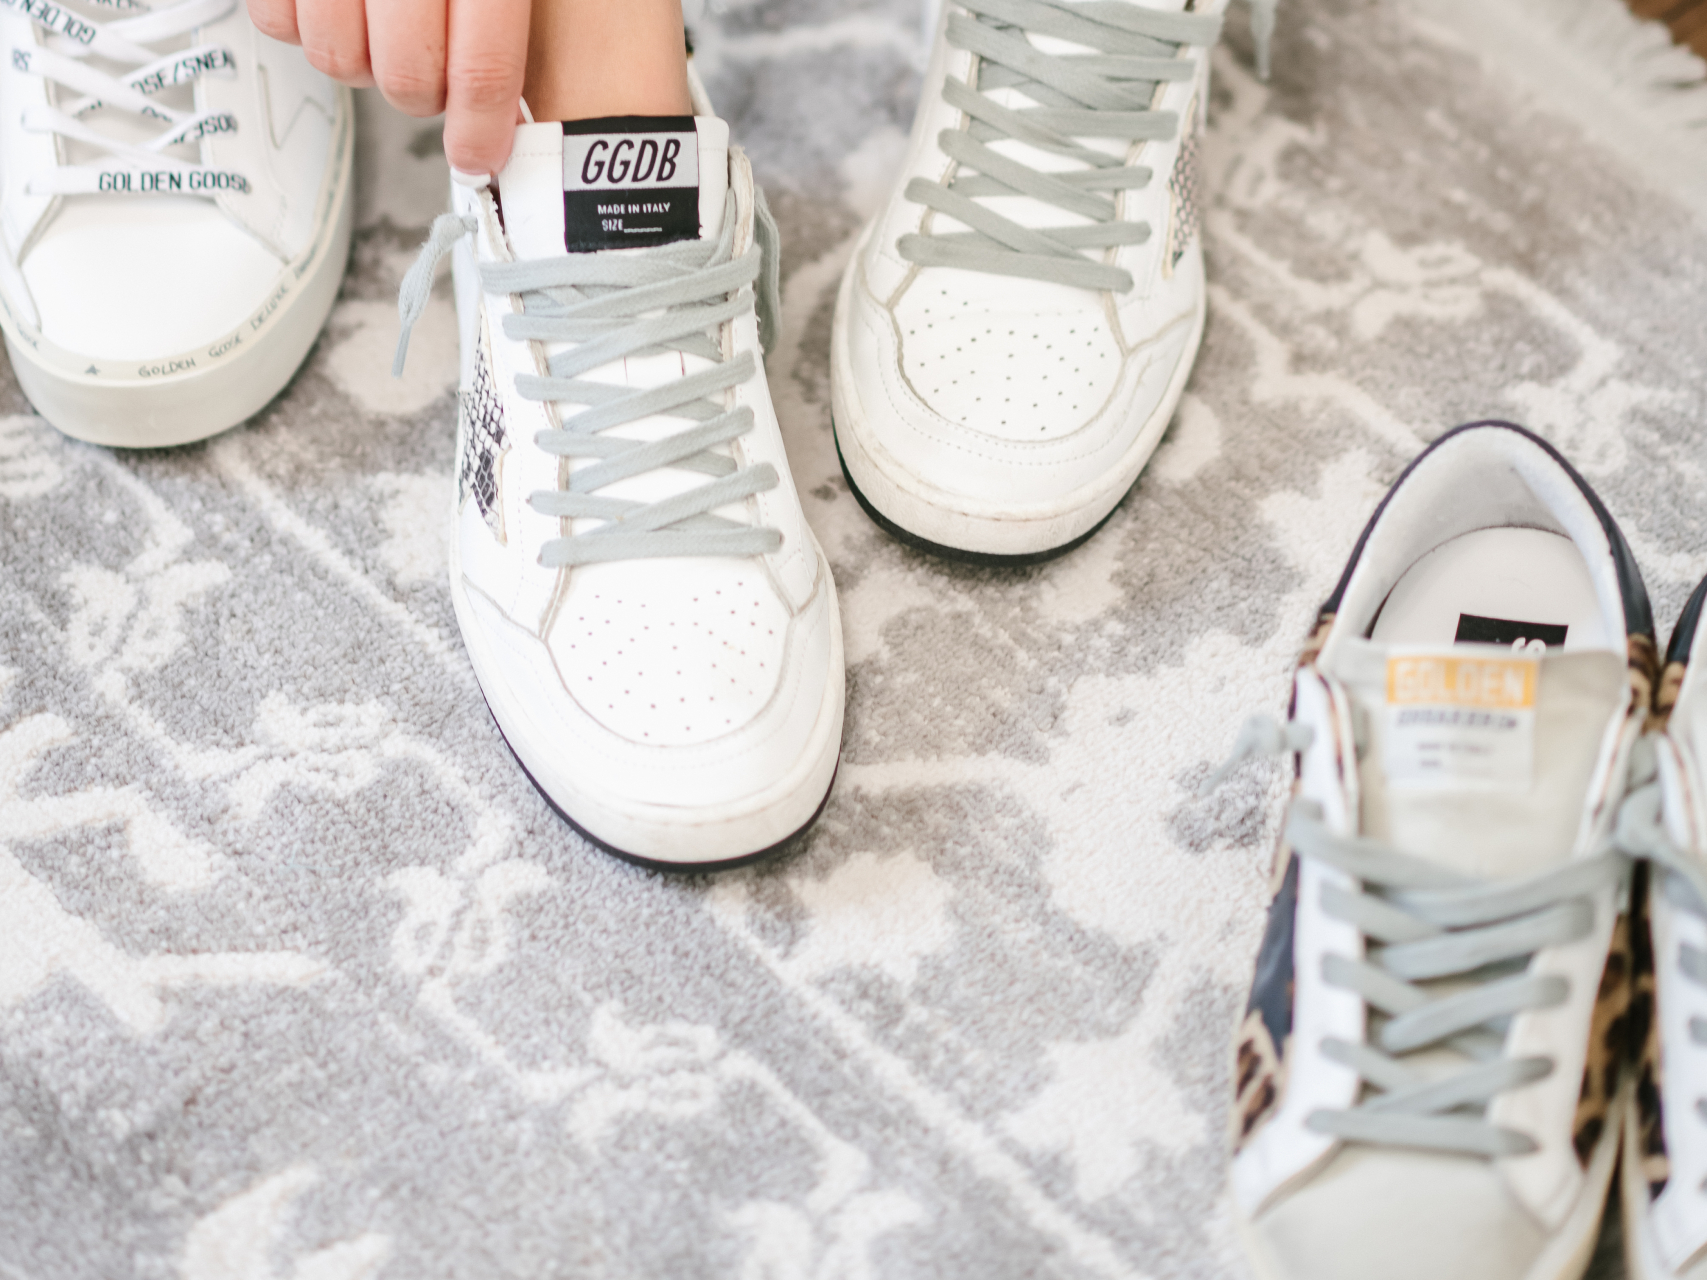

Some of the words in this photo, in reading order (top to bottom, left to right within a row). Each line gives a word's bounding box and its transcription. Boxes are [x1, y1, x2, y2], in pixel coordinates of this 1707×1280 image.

[581, 138, 681, 184] GGDB
[98, 171, 182, 193] GOLDEN
[597, 204, 625, 215] MADE
[628, 204, 640, 214] IN
[643, 202, 670, 213] ITALY
[602, 219, 623, 231] SIZE
[138, 357, 196, 378] GOLDEN
